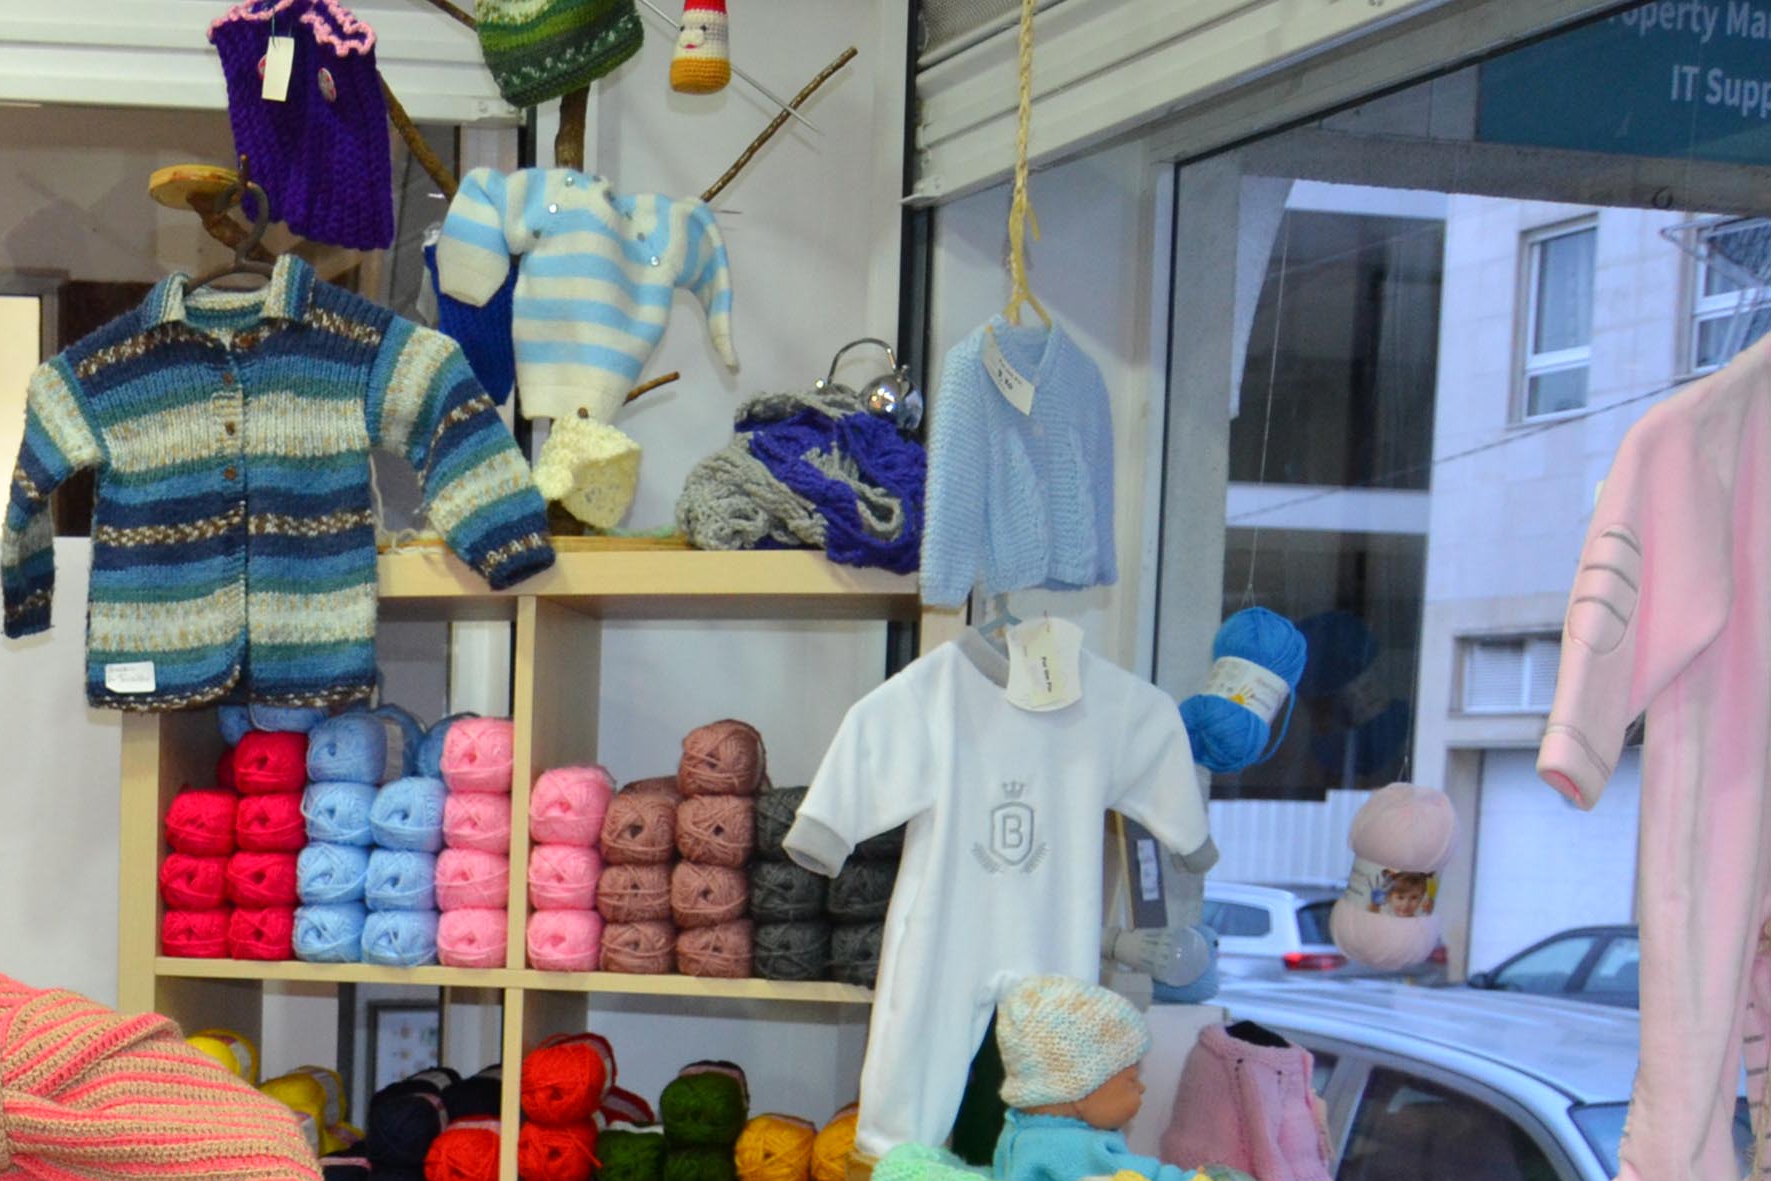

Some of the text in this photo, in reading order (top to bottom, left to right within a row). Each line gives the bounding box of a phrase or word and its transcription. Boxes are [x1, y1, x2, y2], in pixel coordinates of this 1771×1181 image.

[1726, 1, 1771, 40] Ma
[1670, 64, 1701, 102] IT
[1001, 814, 1024, 849] B
